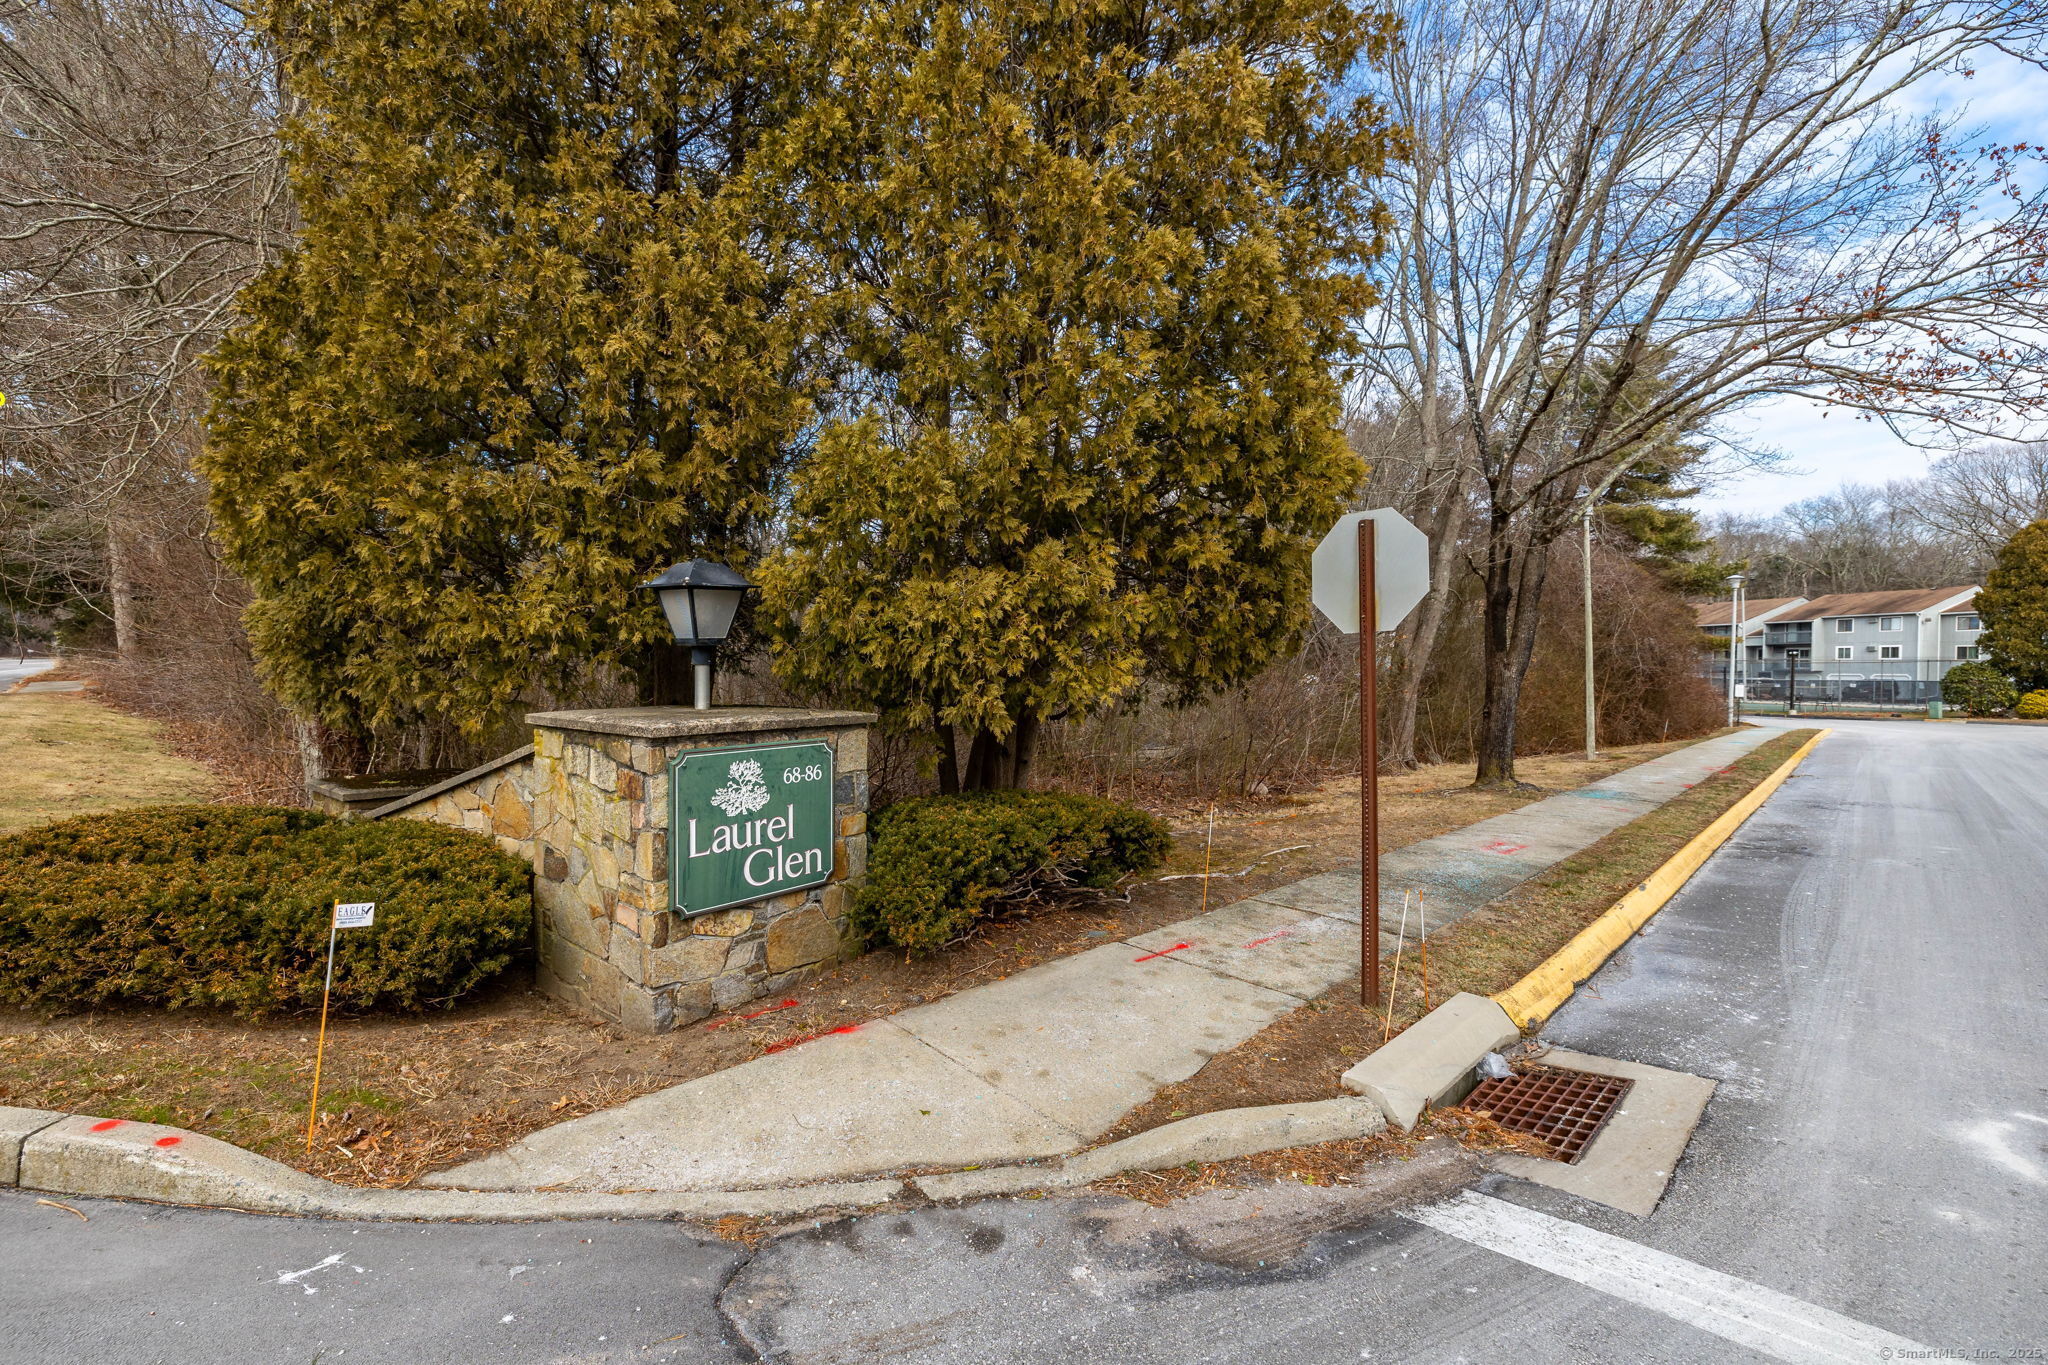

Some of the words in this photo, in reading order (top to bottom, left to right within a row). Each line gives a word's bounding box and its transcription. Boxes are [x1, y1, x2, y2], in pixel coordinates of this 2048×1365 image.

[783, 763, 823, 784] 68-86
[688, 803, 794, 858] Laurel
[743, 845, 823, 887] Glen
[338, 905, 367, 917] EAGLE
